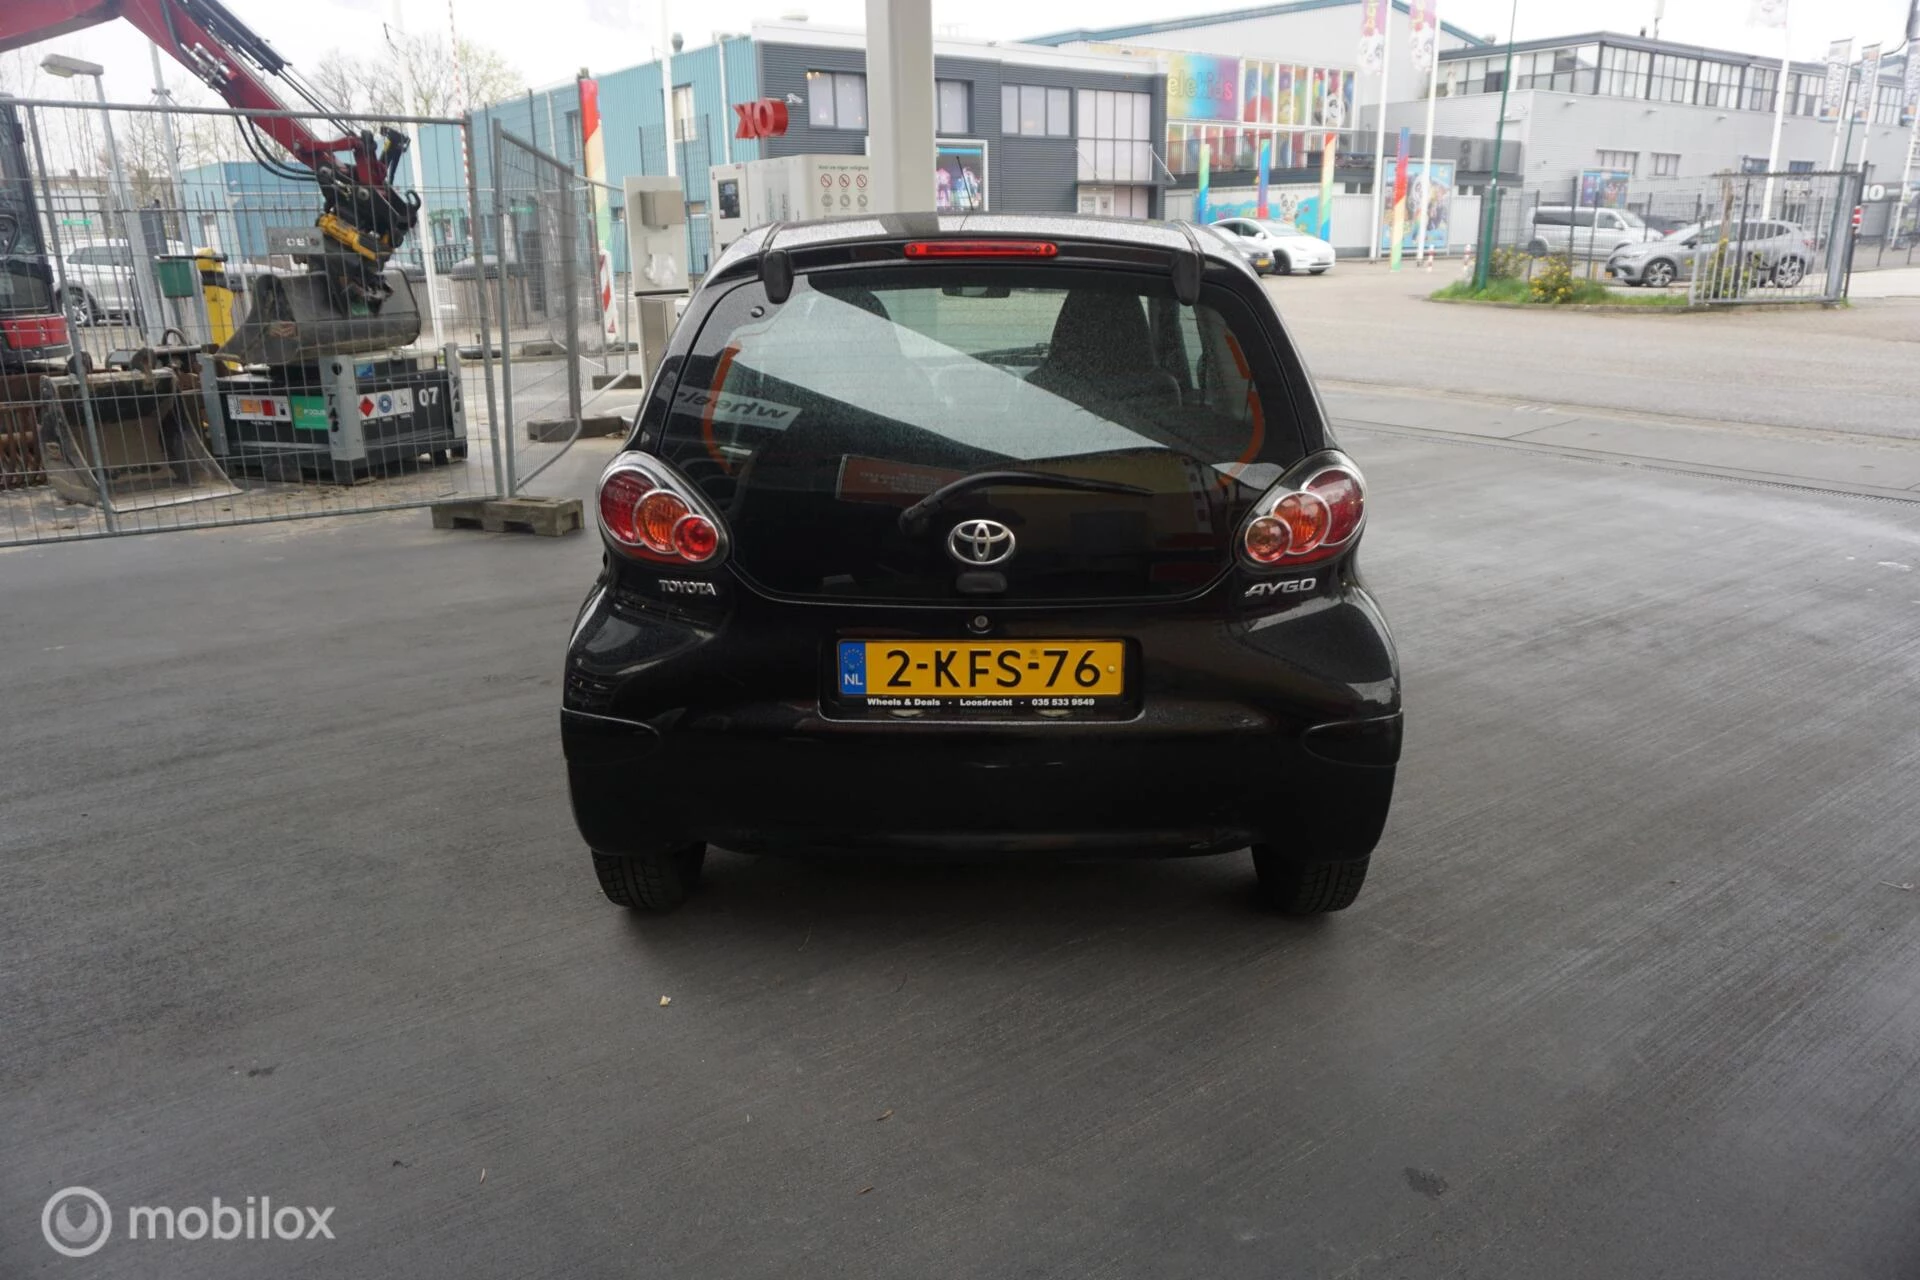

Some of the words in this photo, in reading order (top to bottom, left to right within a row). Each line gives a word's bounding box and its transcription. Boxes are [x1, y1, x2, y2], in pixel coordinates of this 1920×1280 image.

[418, 387, 438, 407] 07
[658, 579, 717, 596] TOYOTA
[1244, 577, 1317, 597] AYGO
[887, 649, 1101, 688] 2-KFS-76
[844, 673, 863, 686] NL
[867, 698, 901, 706] Wheels
[904, 698, 912, 706] &
[914, 698, 940, 706] Deals
[960, 698, 1013, 706] Loosdrecht
[1031, 698, 1049, 706] 035
[1051, 698, 1069, 706] 533
[1071, 698, 1095, 706] 9549
